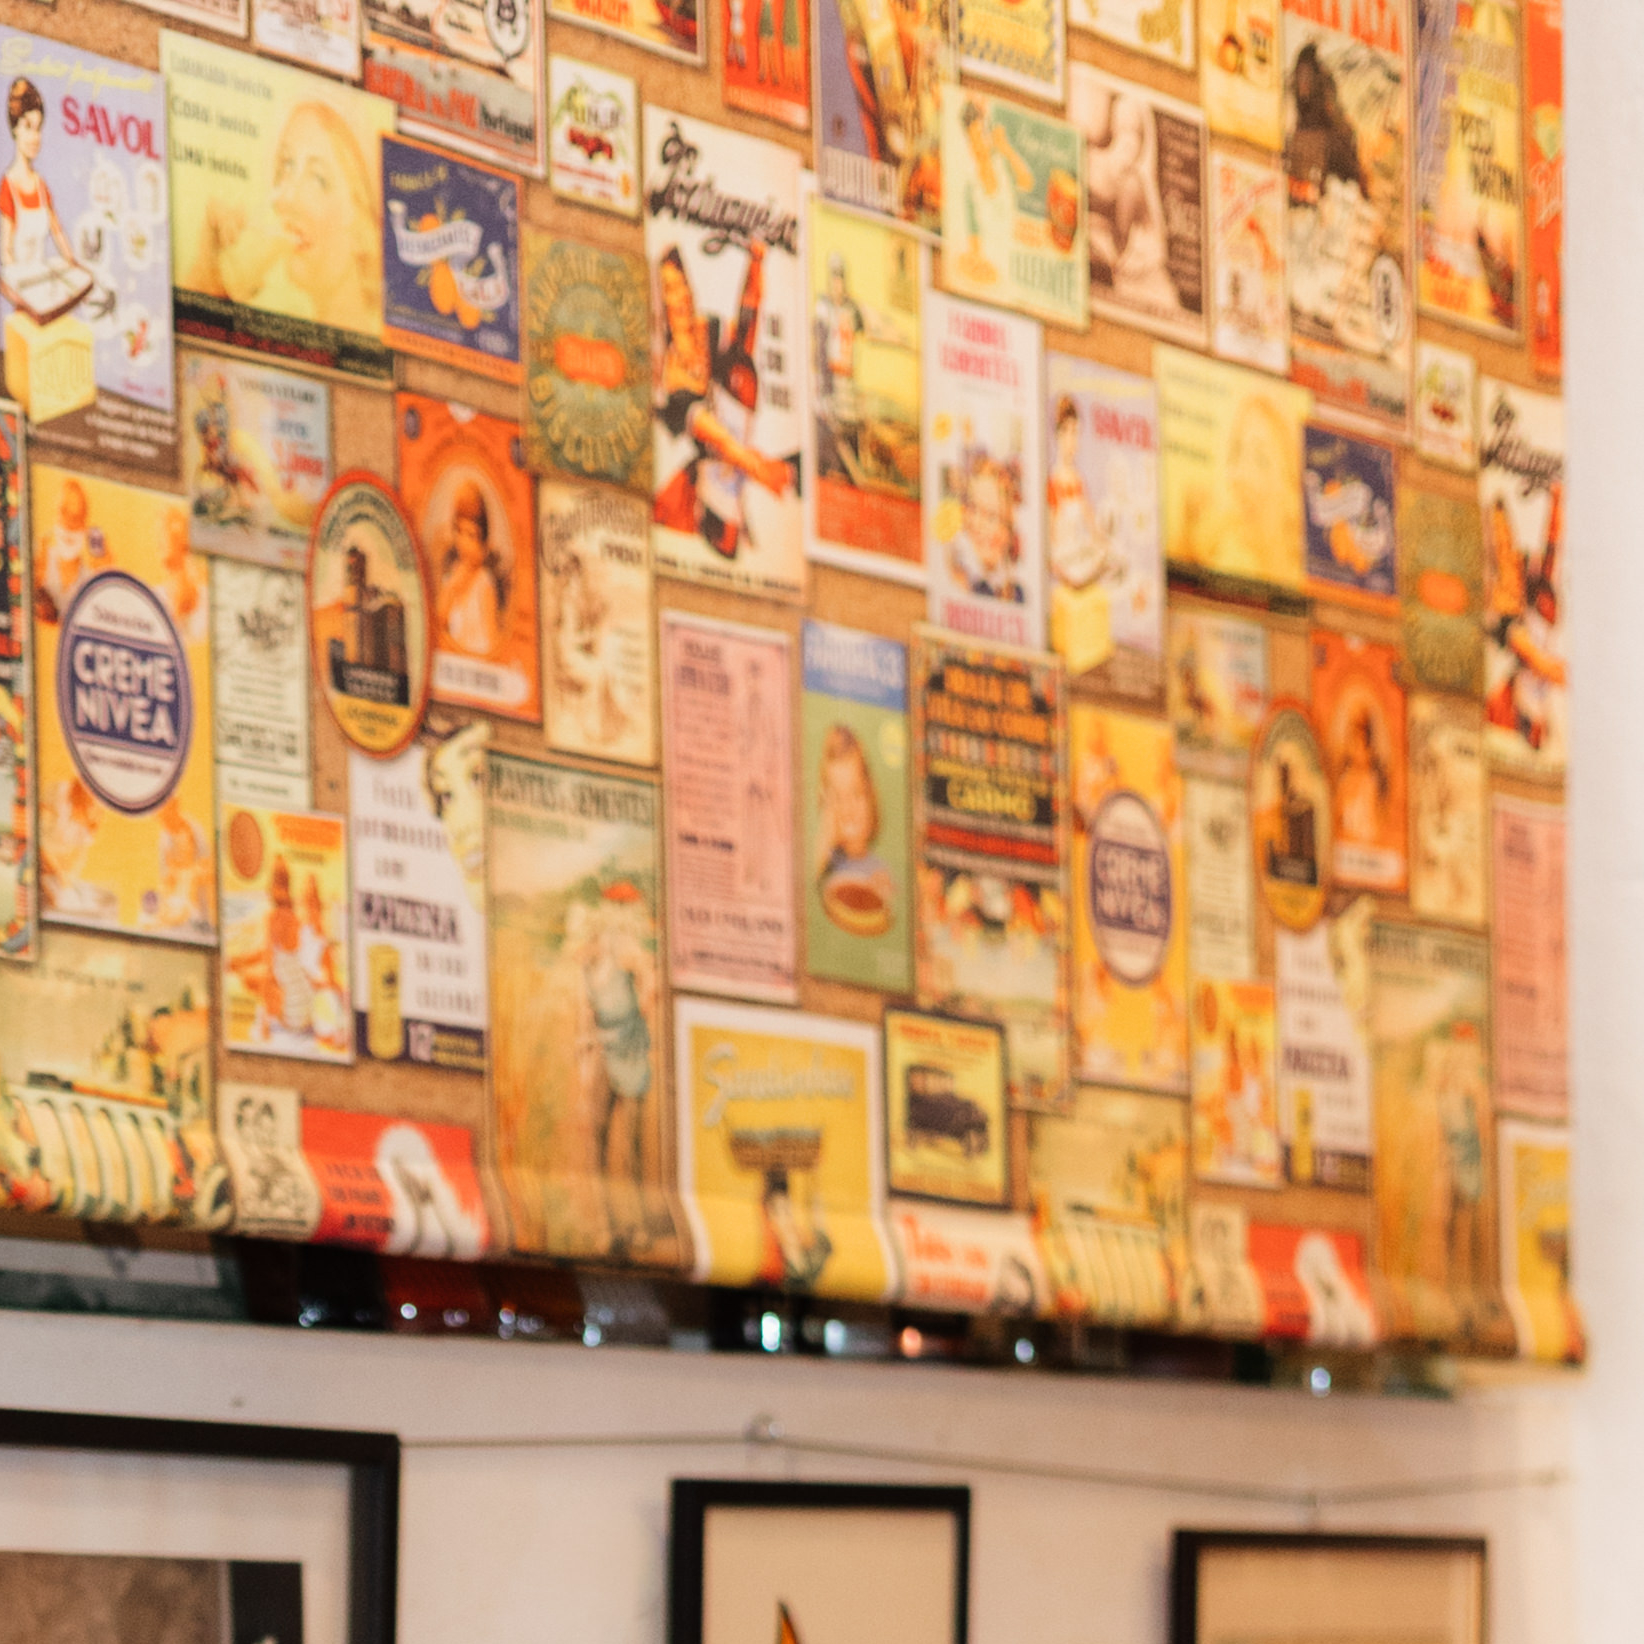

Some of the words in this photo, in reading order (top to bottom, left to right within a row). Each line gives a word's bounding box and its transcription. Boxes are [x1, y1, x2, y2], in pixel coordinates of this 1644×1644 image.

[61, 95, 160, 160] SAVOL
[73, 642, 176, 703] CREME
[73, 684, 177, 748] NIVEA
